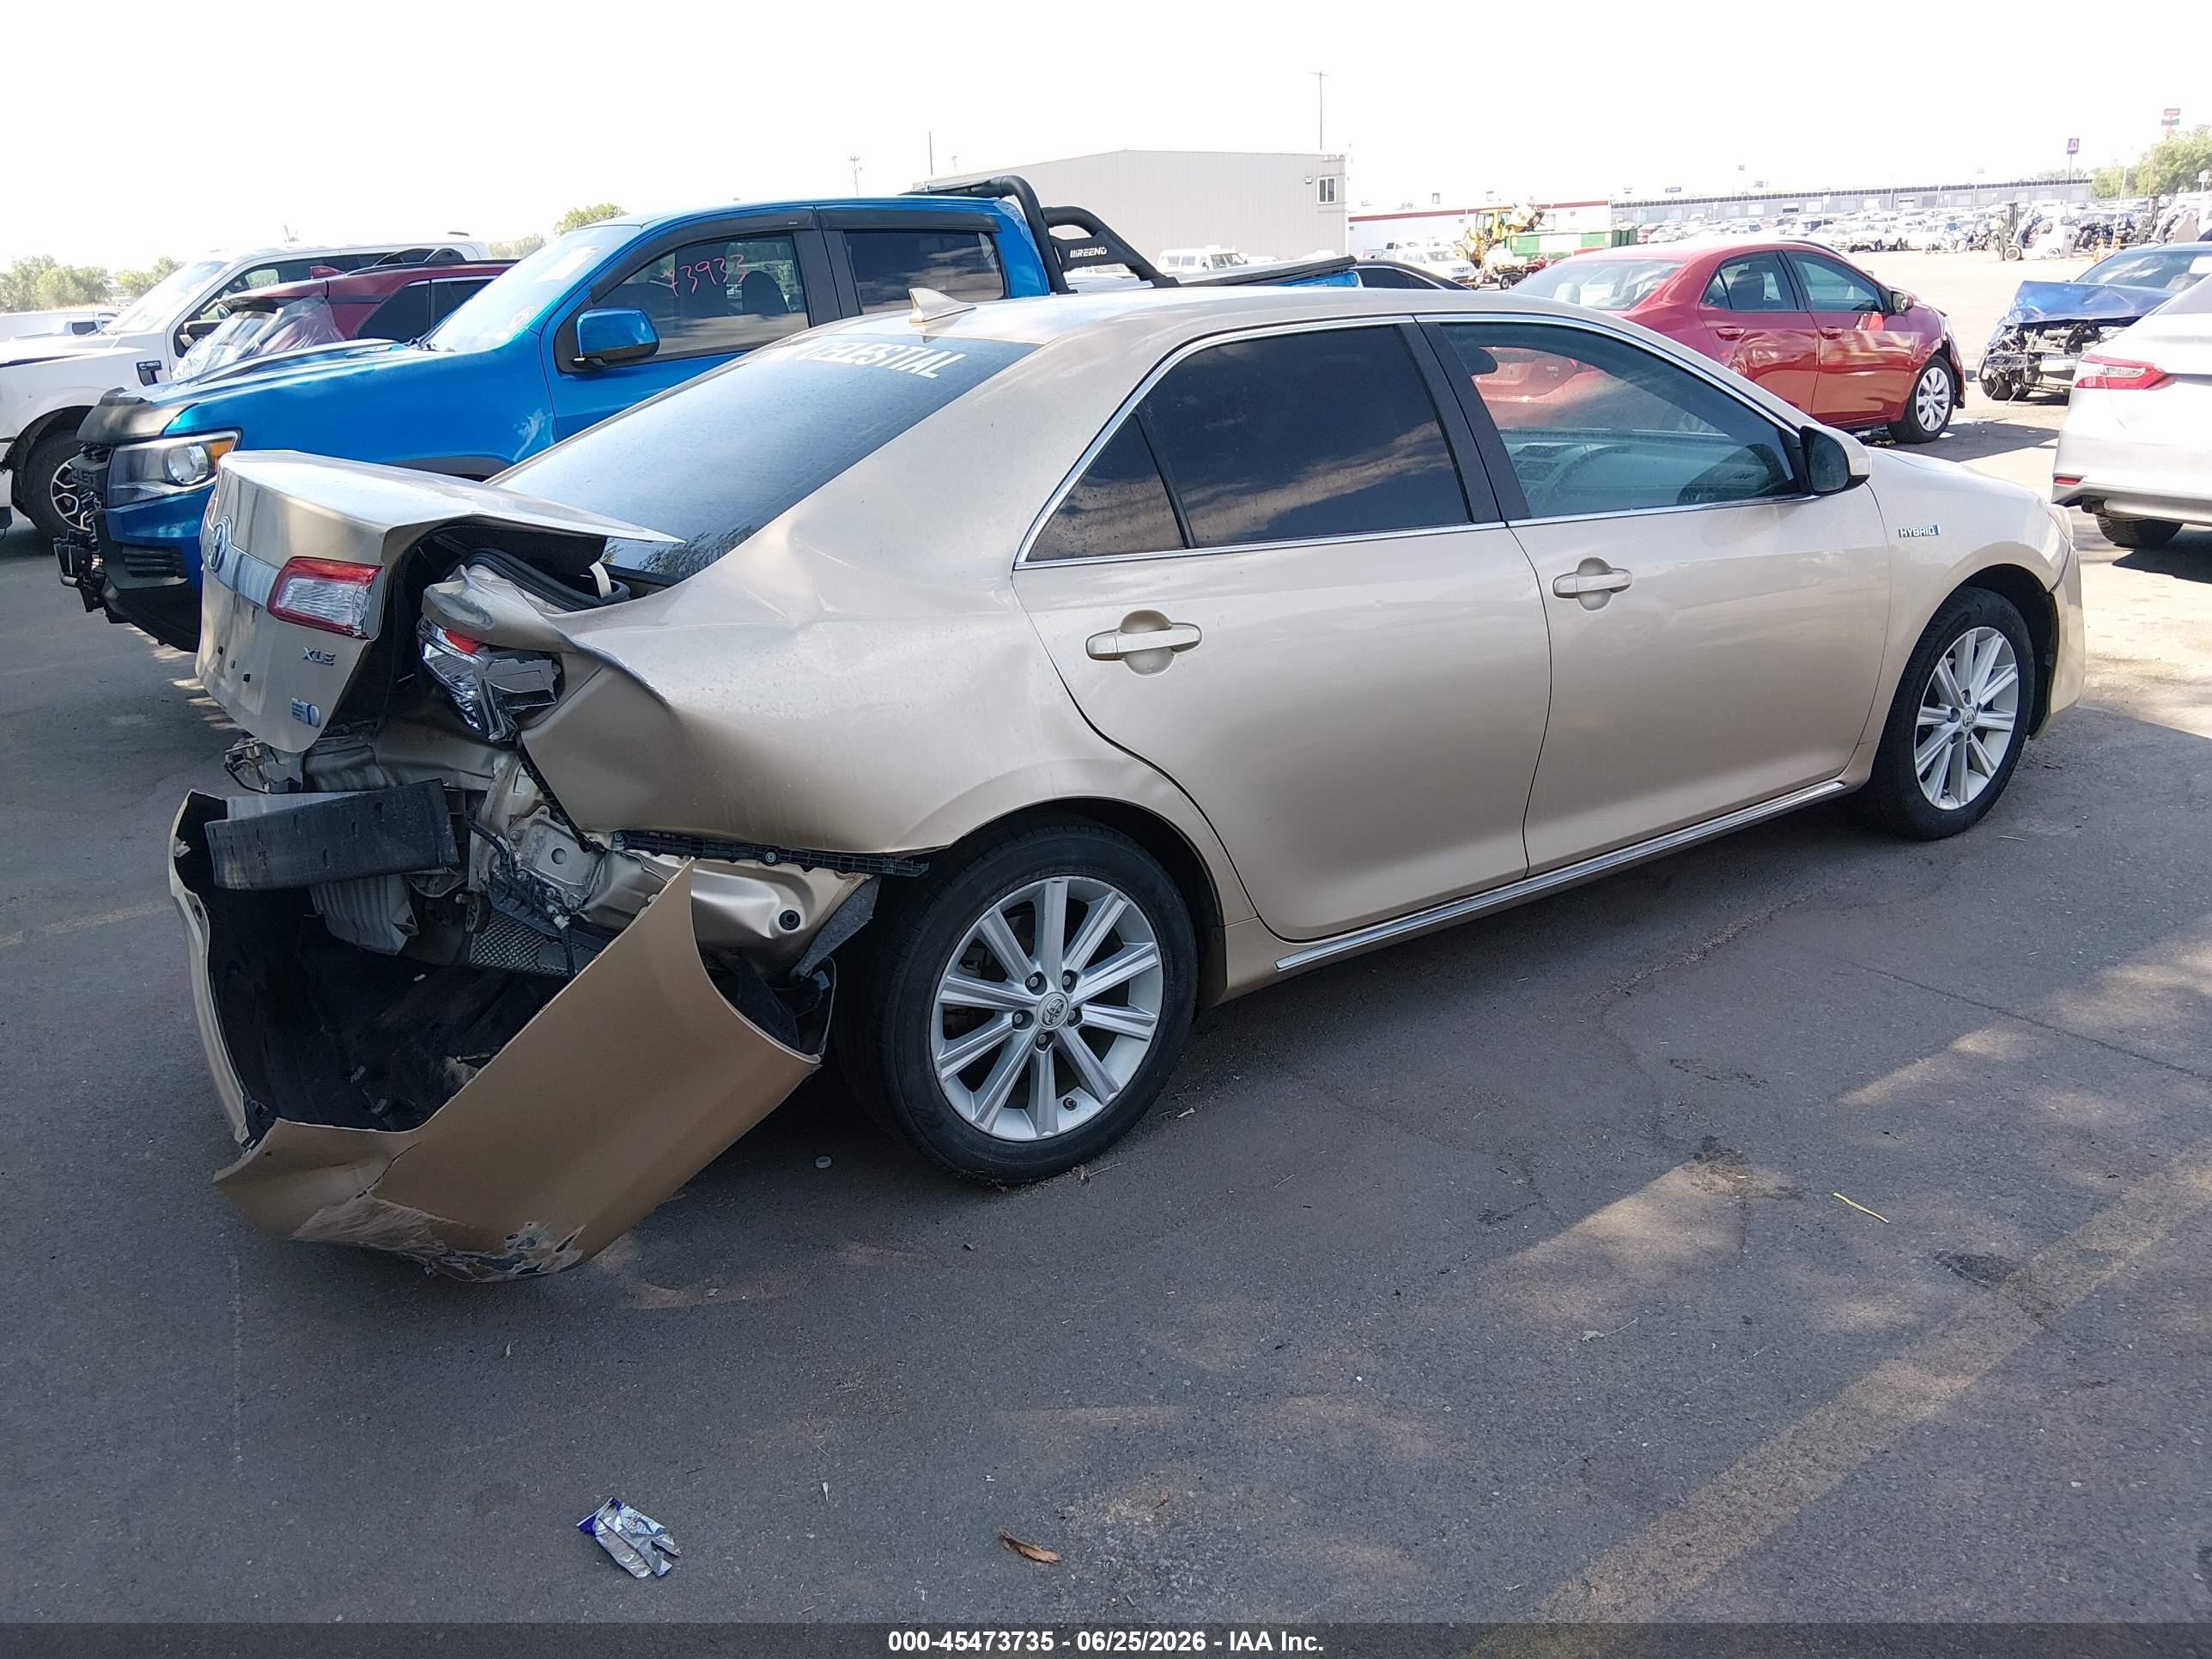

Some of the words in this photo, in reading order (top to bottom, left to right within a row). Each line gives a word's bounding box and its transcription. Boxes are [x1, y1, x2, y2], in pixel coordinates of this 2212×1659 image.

[795, 342, 968, 379] CELESTIAL
[1899, 526, 1936, 538] HYBRID
[302, 647, 337, 666] XLE
